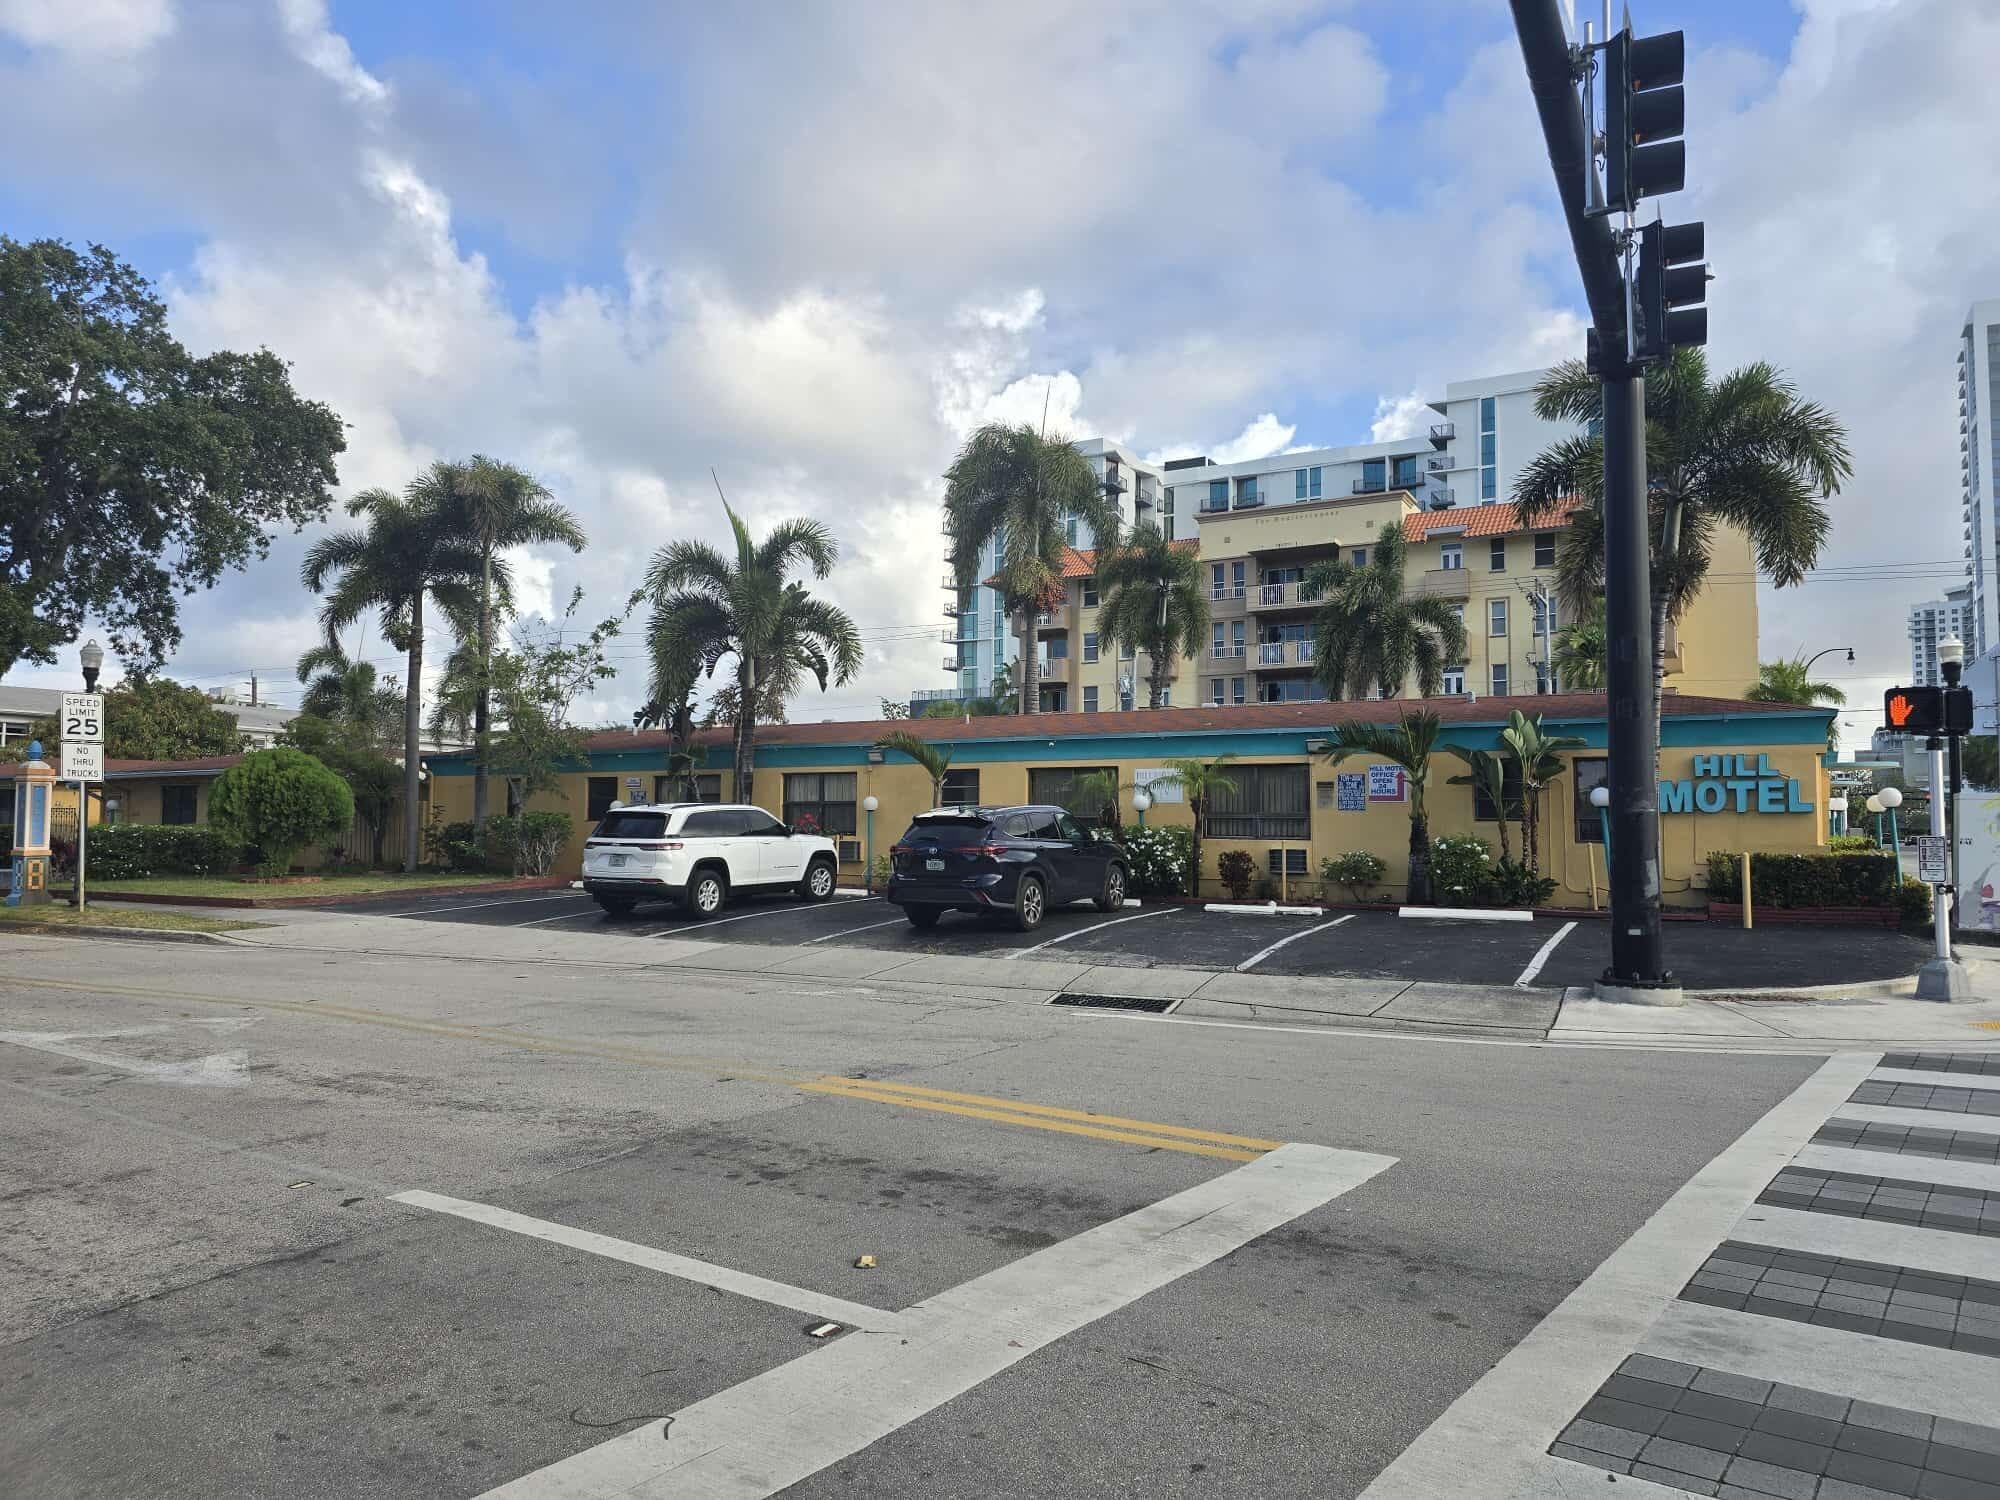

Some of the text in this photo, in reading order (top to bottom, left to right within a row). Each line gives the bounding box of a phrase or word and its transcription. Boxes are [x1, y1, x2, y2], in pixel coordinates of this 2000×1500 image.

[65, 698, 100, 707] SPEED
[69, 708, 96, 716] LIMIT
[66, 718, 98, 735] 25
[76, 747, 89, 755] NO
[72, 758, 94, 766] THRU
[1693, 752, 1780, 777] HILL
[67, 769, 99, 778] TRUCKS
[1659, 778, 1815, 814] MOTEL
